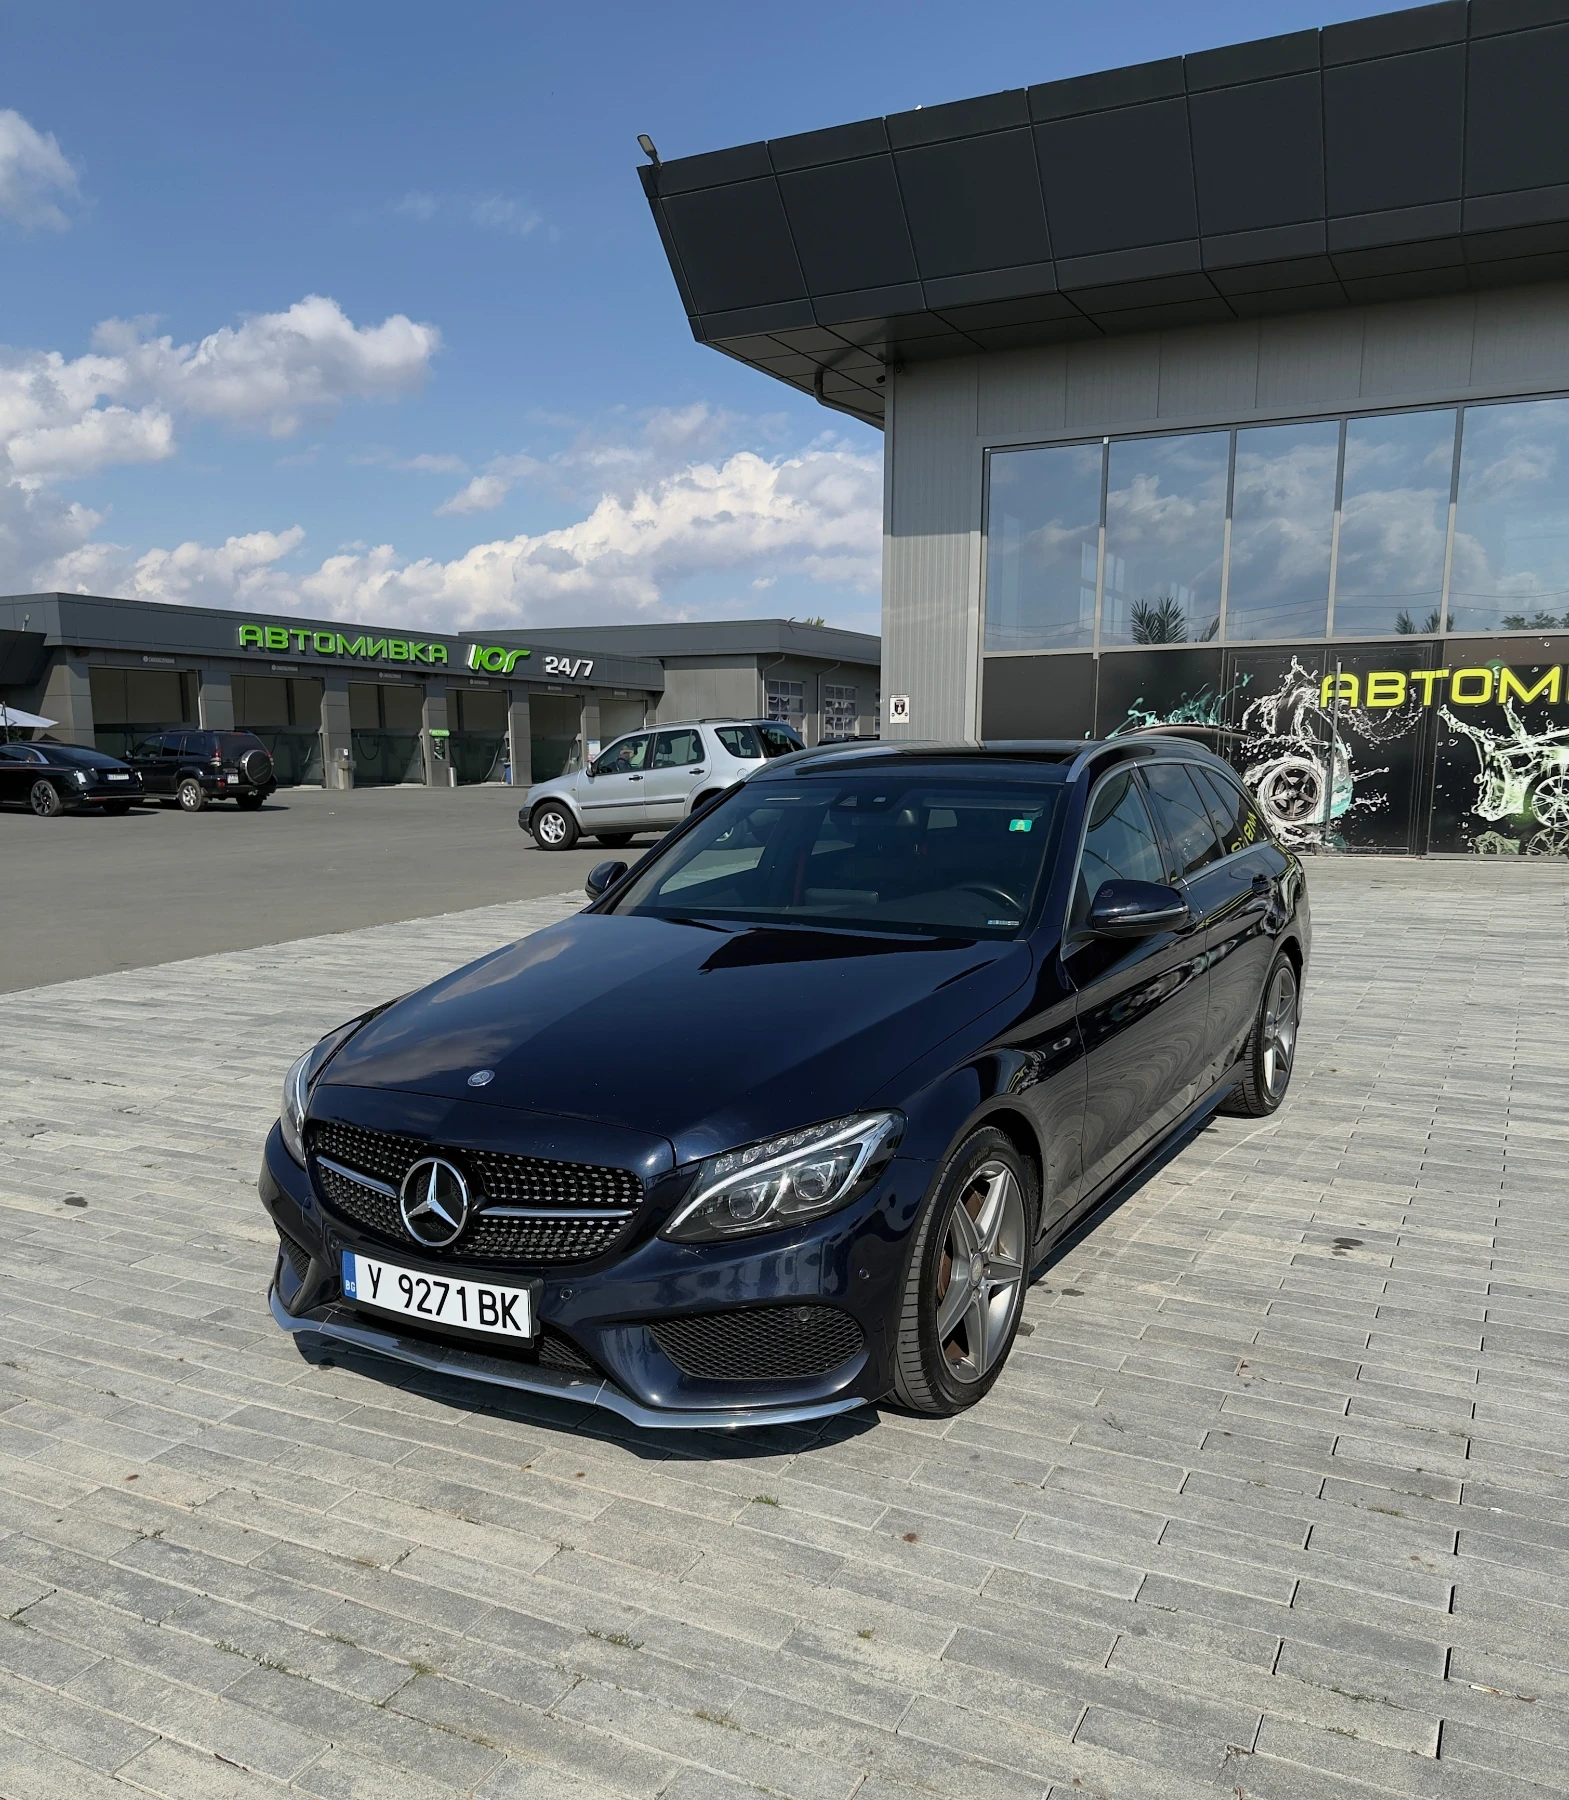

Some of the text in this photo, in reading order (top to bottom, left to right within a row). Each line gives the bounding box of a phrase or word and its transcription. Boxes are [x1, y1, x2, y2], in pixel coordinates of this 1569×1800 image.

[239, 624, 448, 665] АВТОМИВКА
[544, 656, 594, 678] 24/7
[1319, 665, 1569, 709] АВТОМ
[345, 1279, 356, 1293] BG
